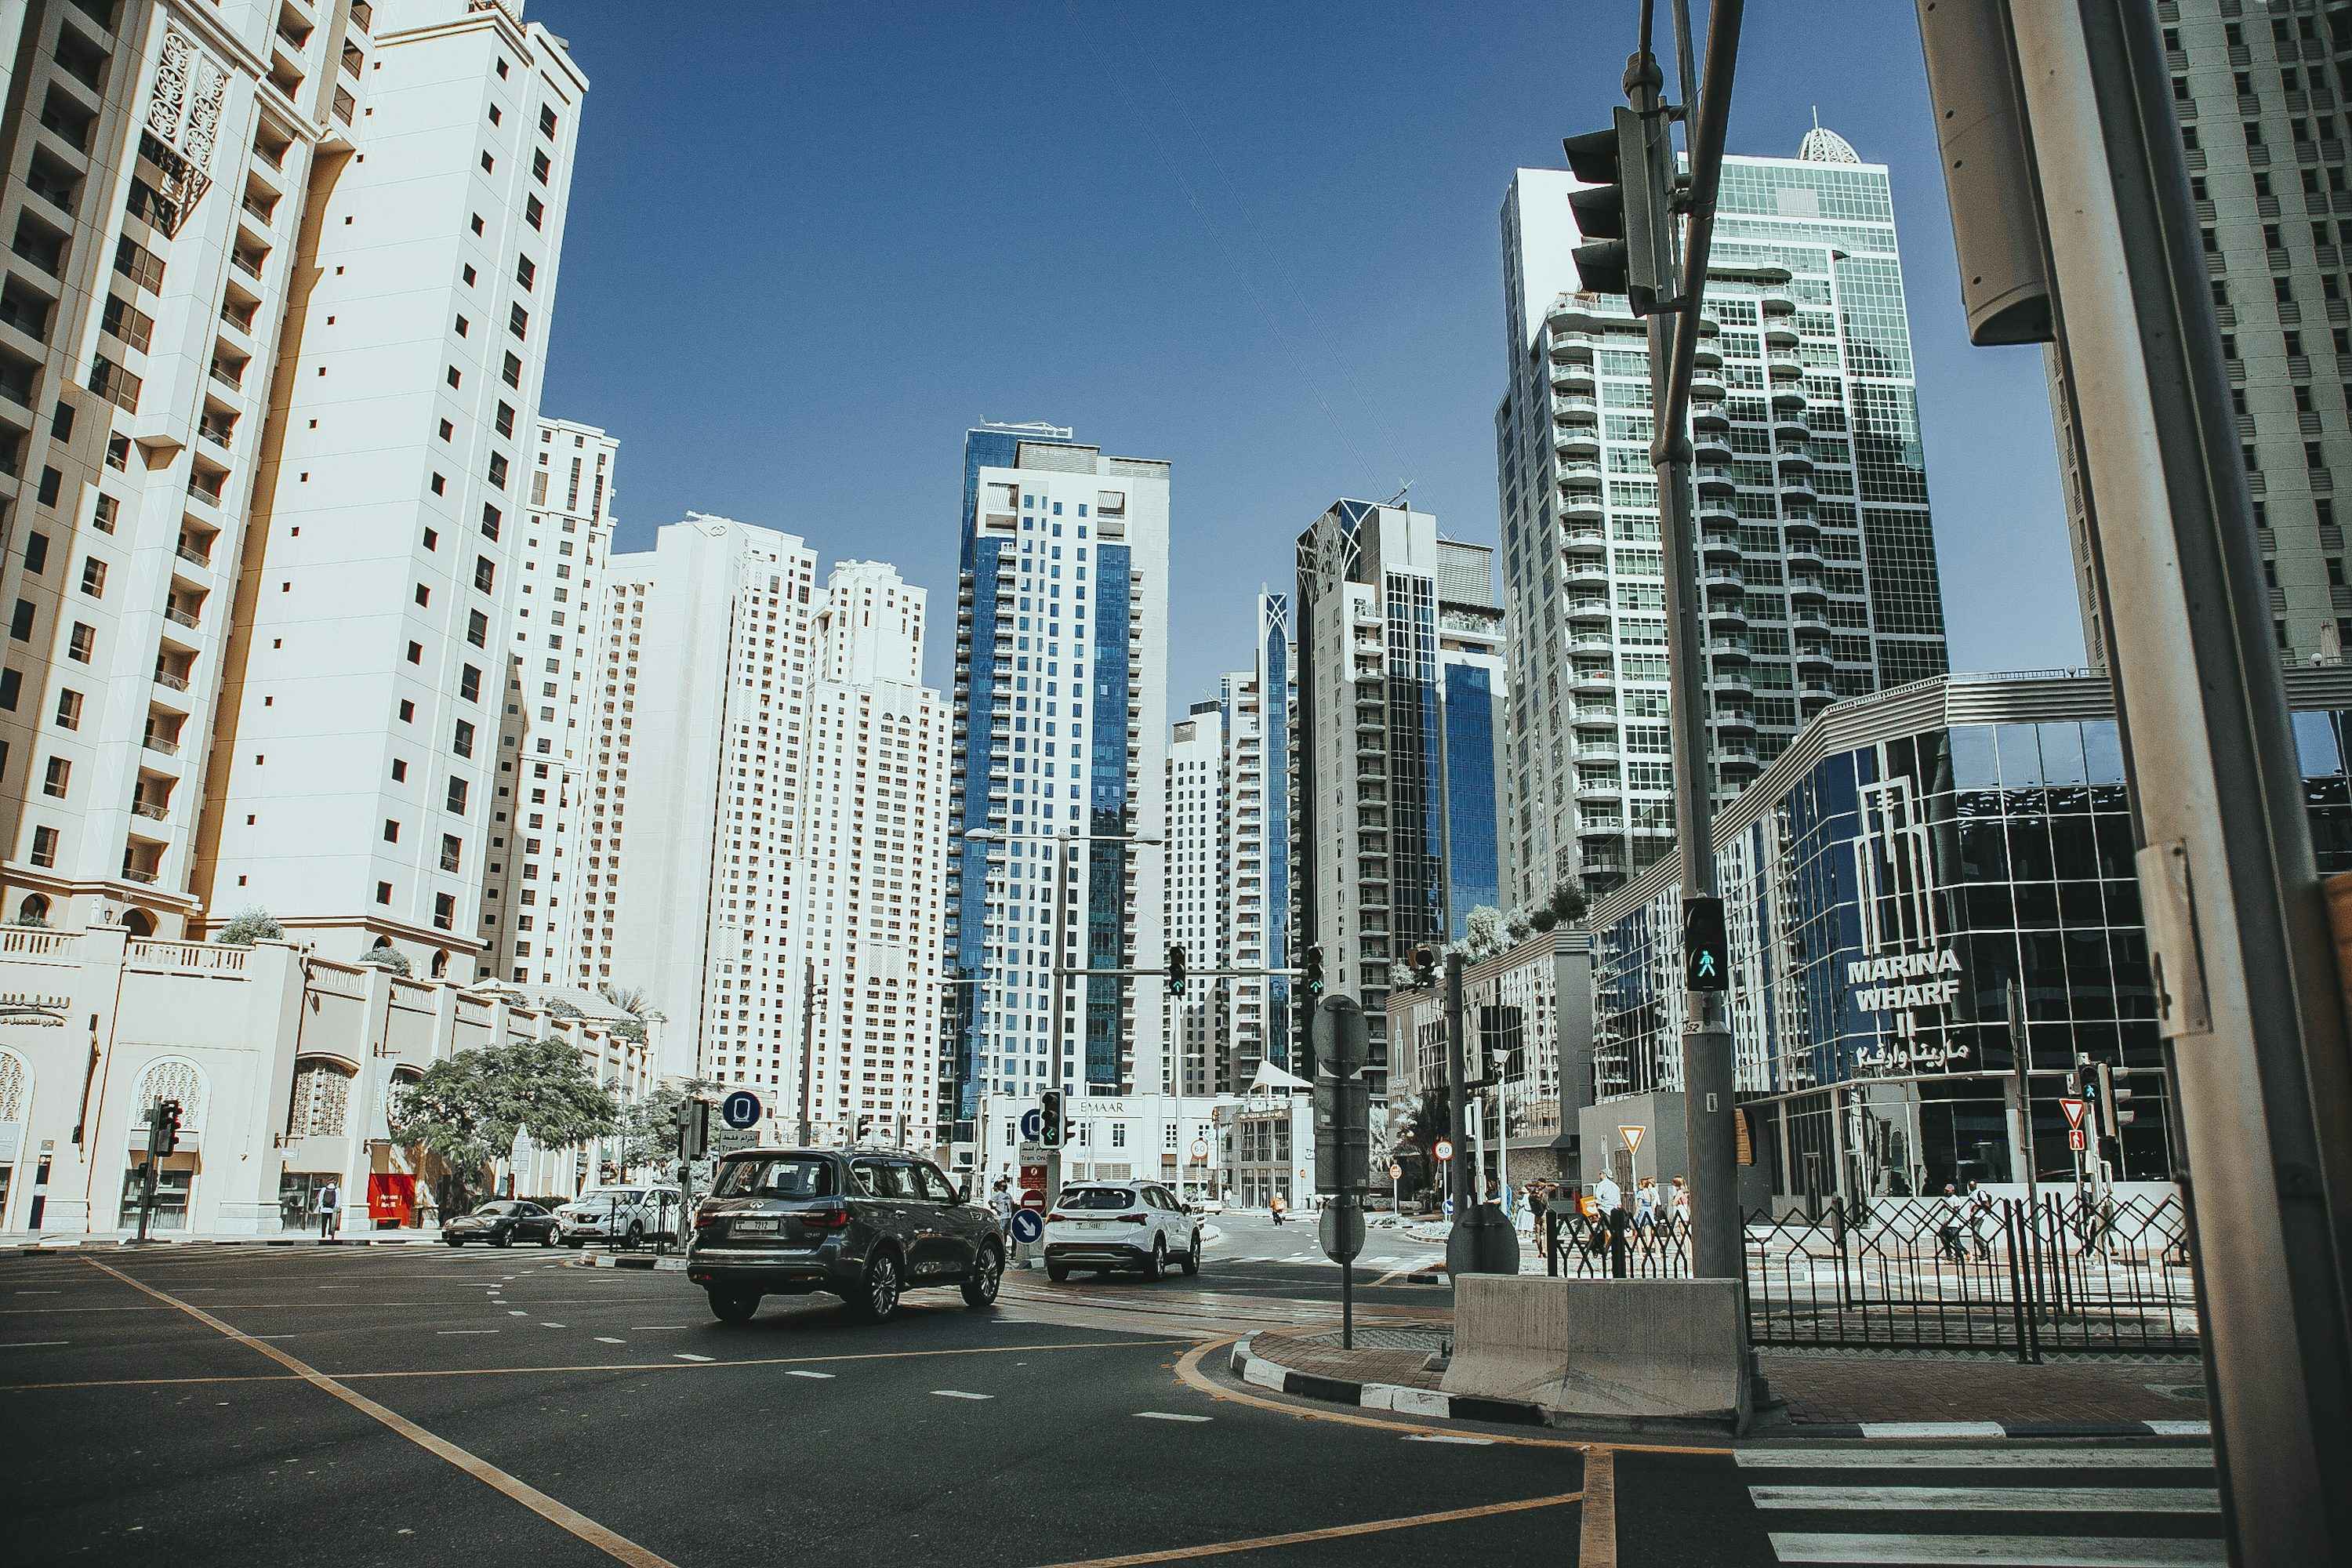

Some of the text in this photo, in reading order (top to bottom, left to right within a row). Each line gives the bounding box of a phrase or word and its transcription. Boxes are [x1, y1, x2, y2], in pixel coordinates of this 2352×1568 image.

[1847, 948, 1962, 984] MARINA
[1855, 979, 1959, 1012] WHARF
[1080, 1102, 1124, 1112] EMAAR
